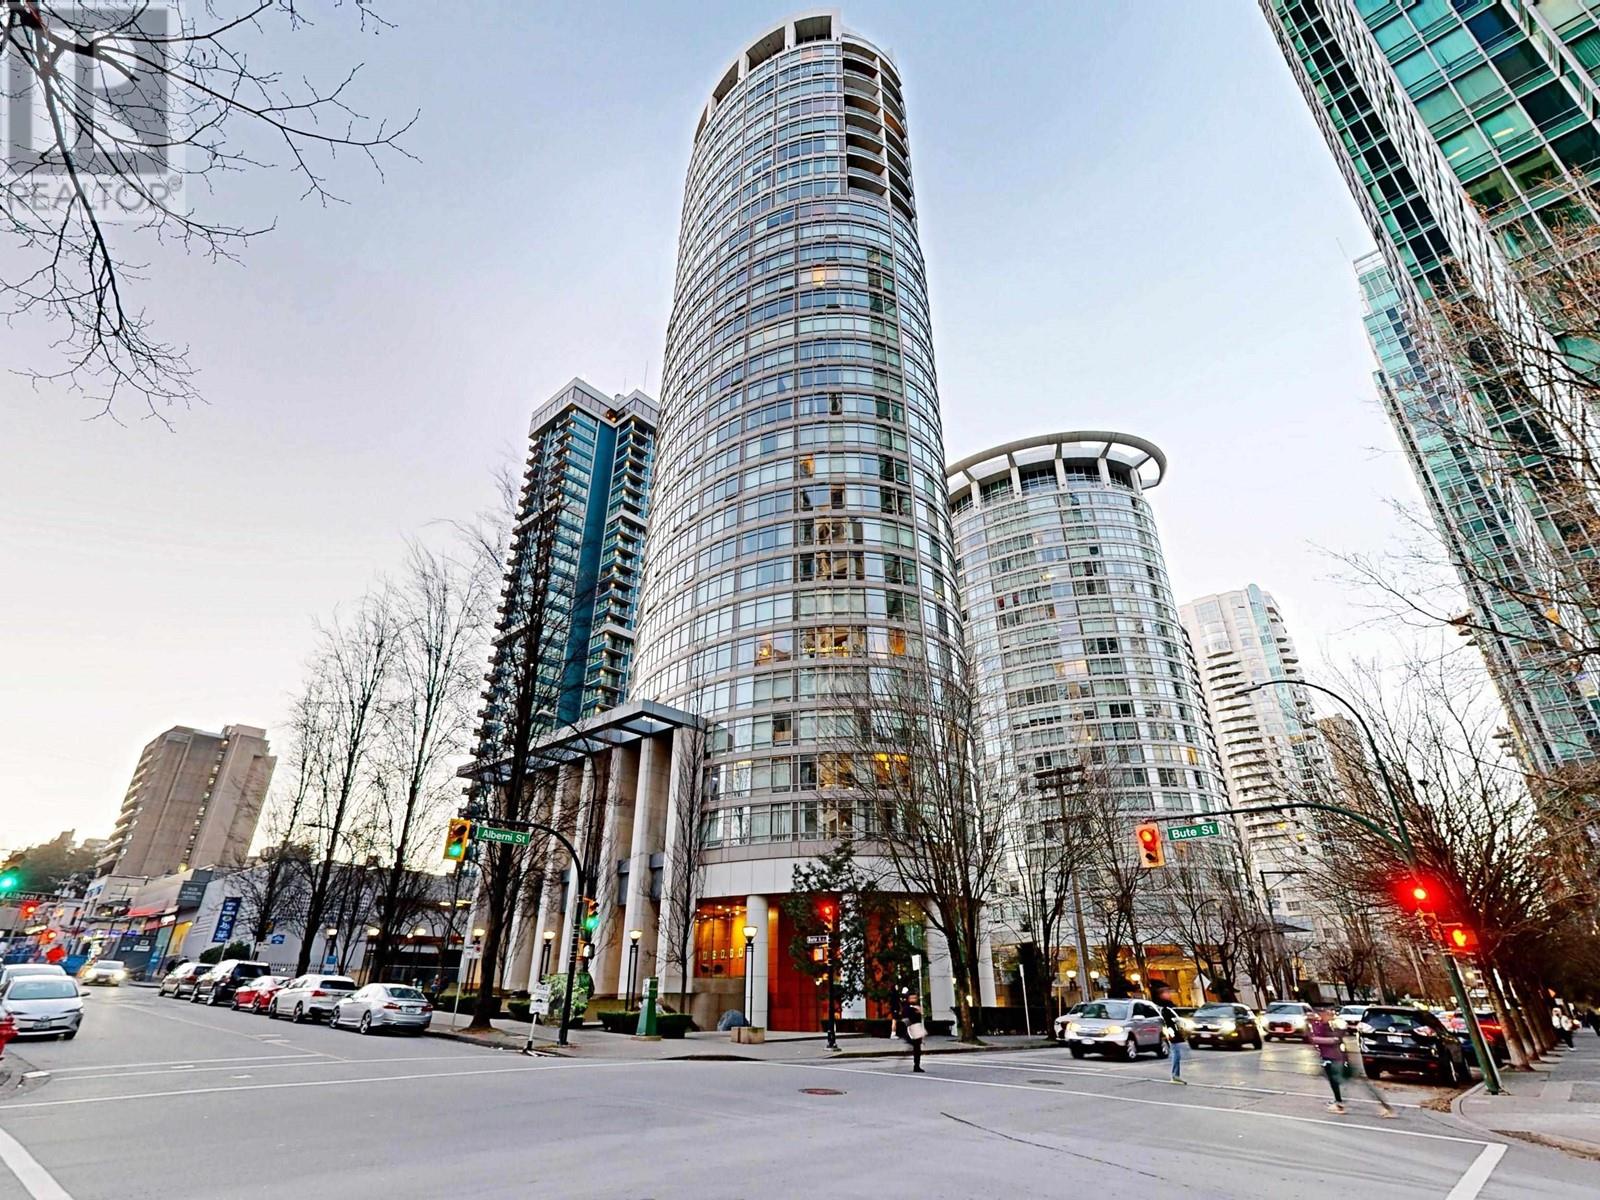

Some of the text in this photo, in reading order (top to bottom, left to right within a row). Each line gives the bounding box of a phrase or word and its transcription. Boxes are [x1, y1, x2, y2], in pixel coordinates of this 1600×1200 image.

[482, 830, 525, 843] Alberni St
[1172, 825, 1214, 839] Bute St
